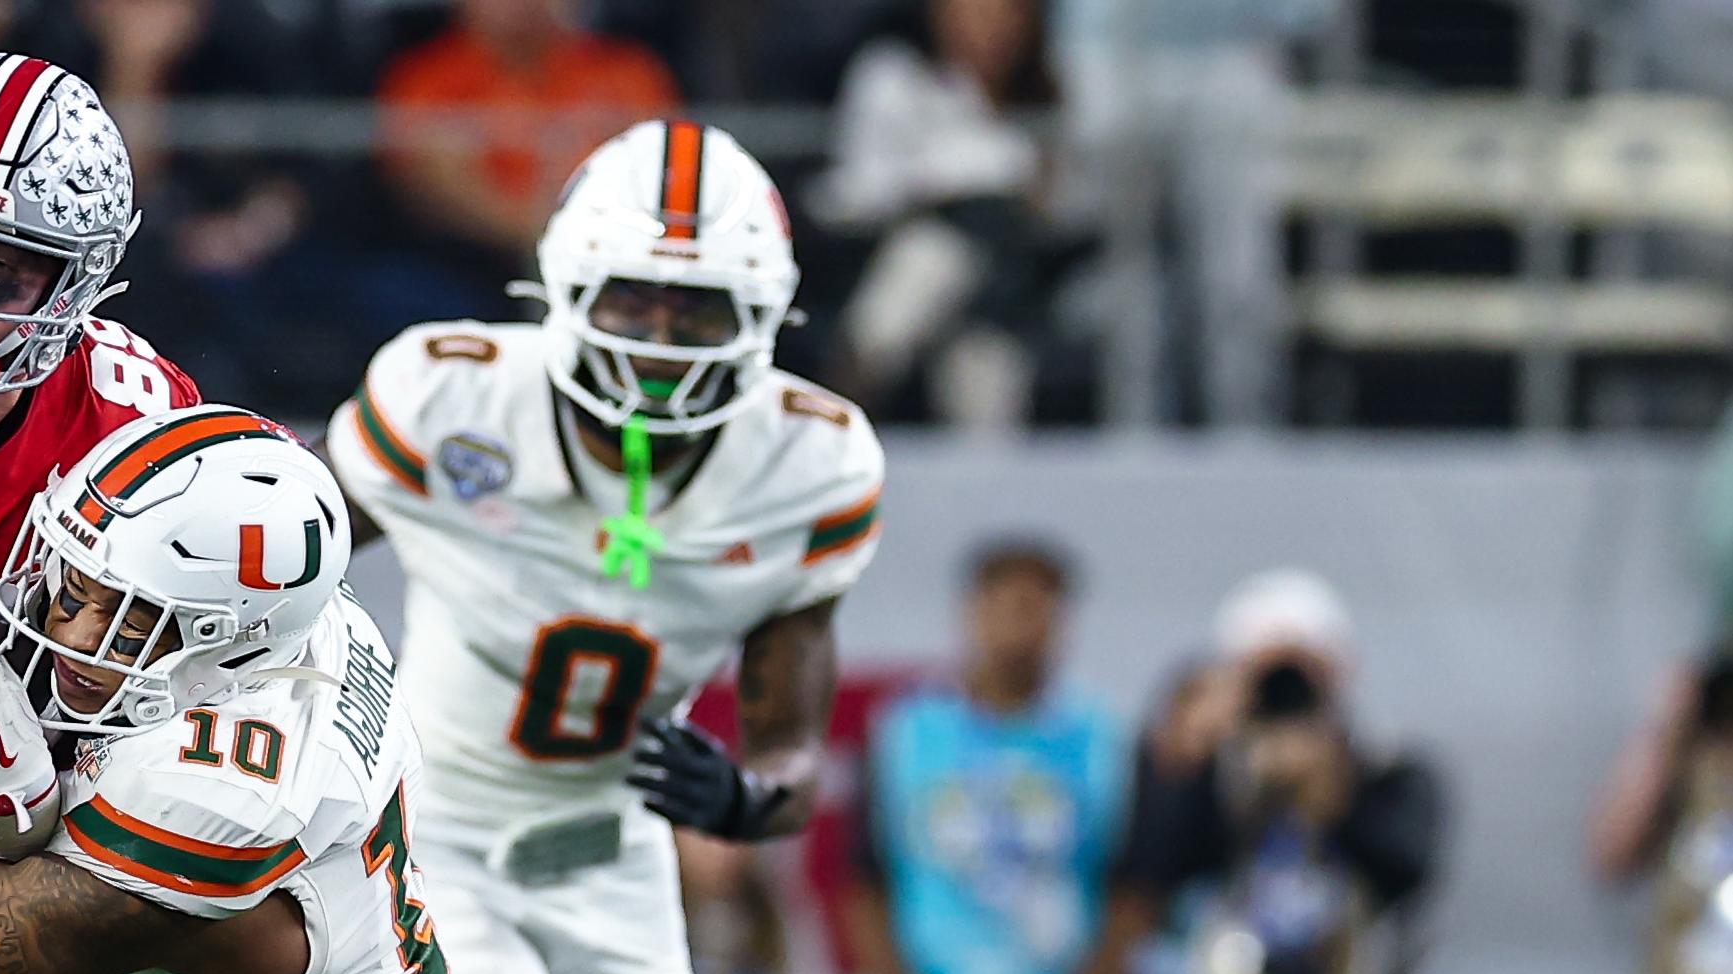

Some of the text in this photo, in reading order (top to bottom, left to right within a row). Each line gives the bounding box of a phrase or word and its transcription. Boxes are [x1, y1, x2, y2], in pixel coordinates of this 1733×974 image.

[56, 509, 98, 550] MIAMI
[237, 519, 321, 591] U
[508, 613, 661, 763] 0
[178, 708, 286, 784] 10
